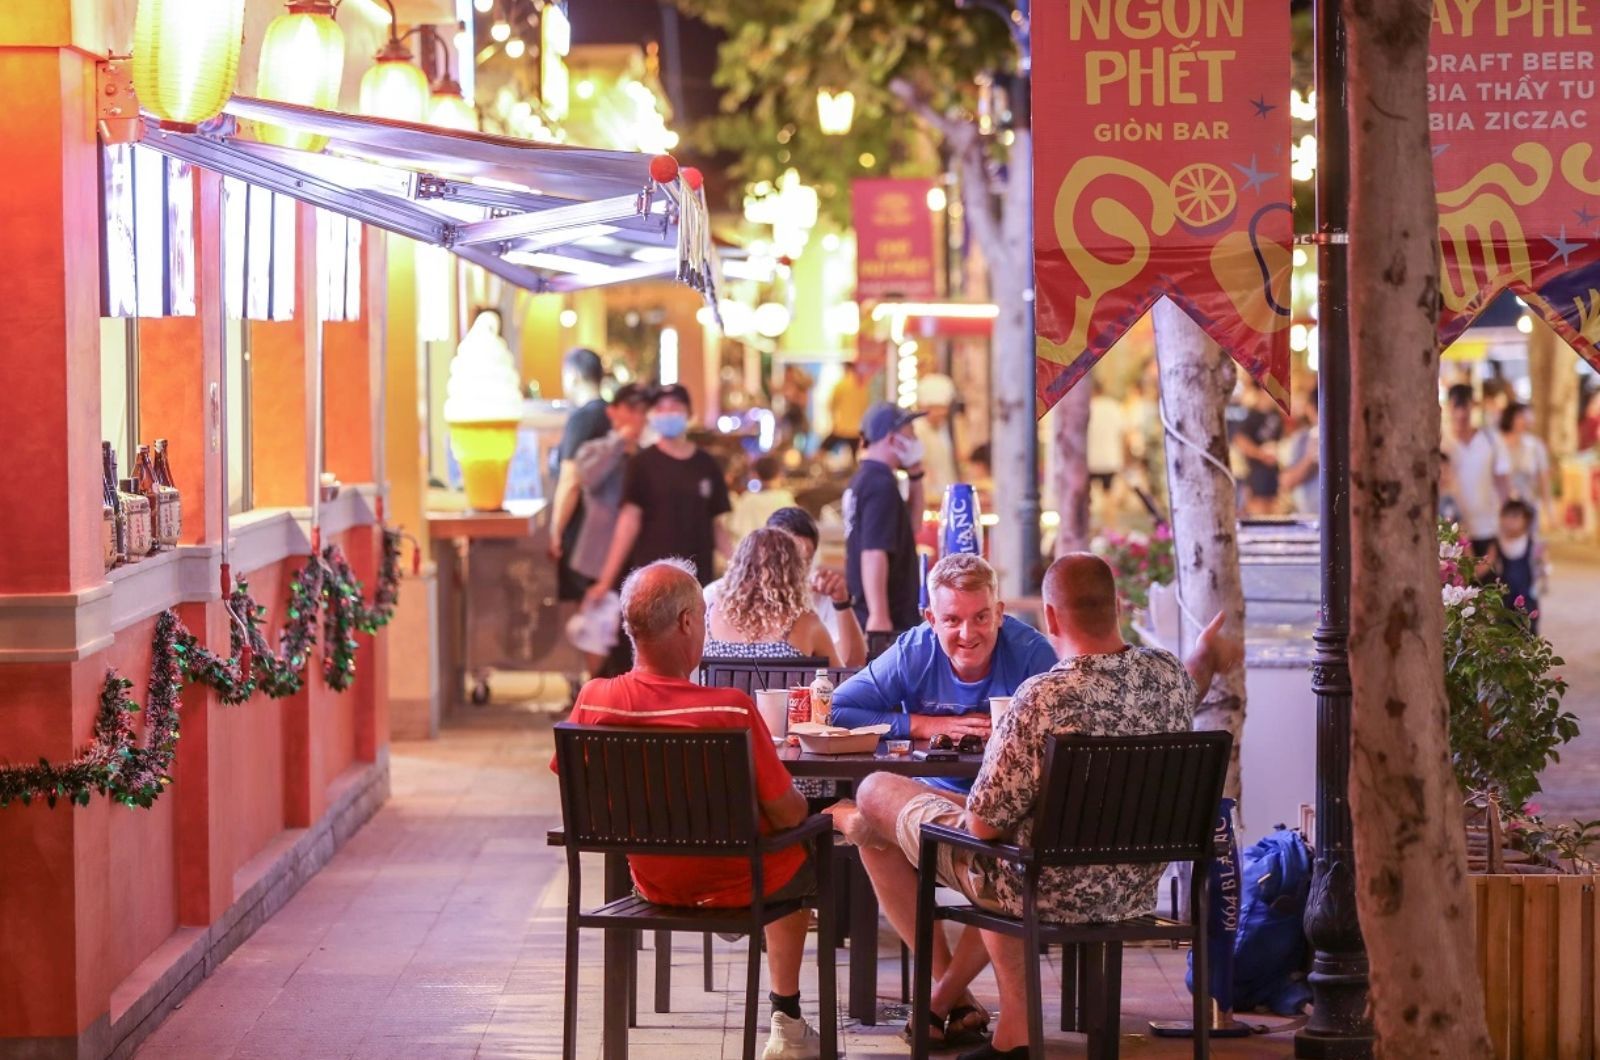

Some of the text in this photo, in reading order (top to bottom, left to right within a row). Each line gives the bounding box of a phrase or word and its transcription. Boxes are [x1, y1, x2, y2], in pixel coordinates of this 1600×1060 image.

[1085, 41, 1236, 107] PHẾT
[1522, 51, 1595, 71] BEER
[1476, 73, 1549, 102] THẦY
[1558, 80, 1595, 100] TU
[1094, 117, 1230, 142] GIÒN BAR
[1428, 109, 1588, 132] BIA ZICZAC
[1220, 895, 1238, 932] 1664
